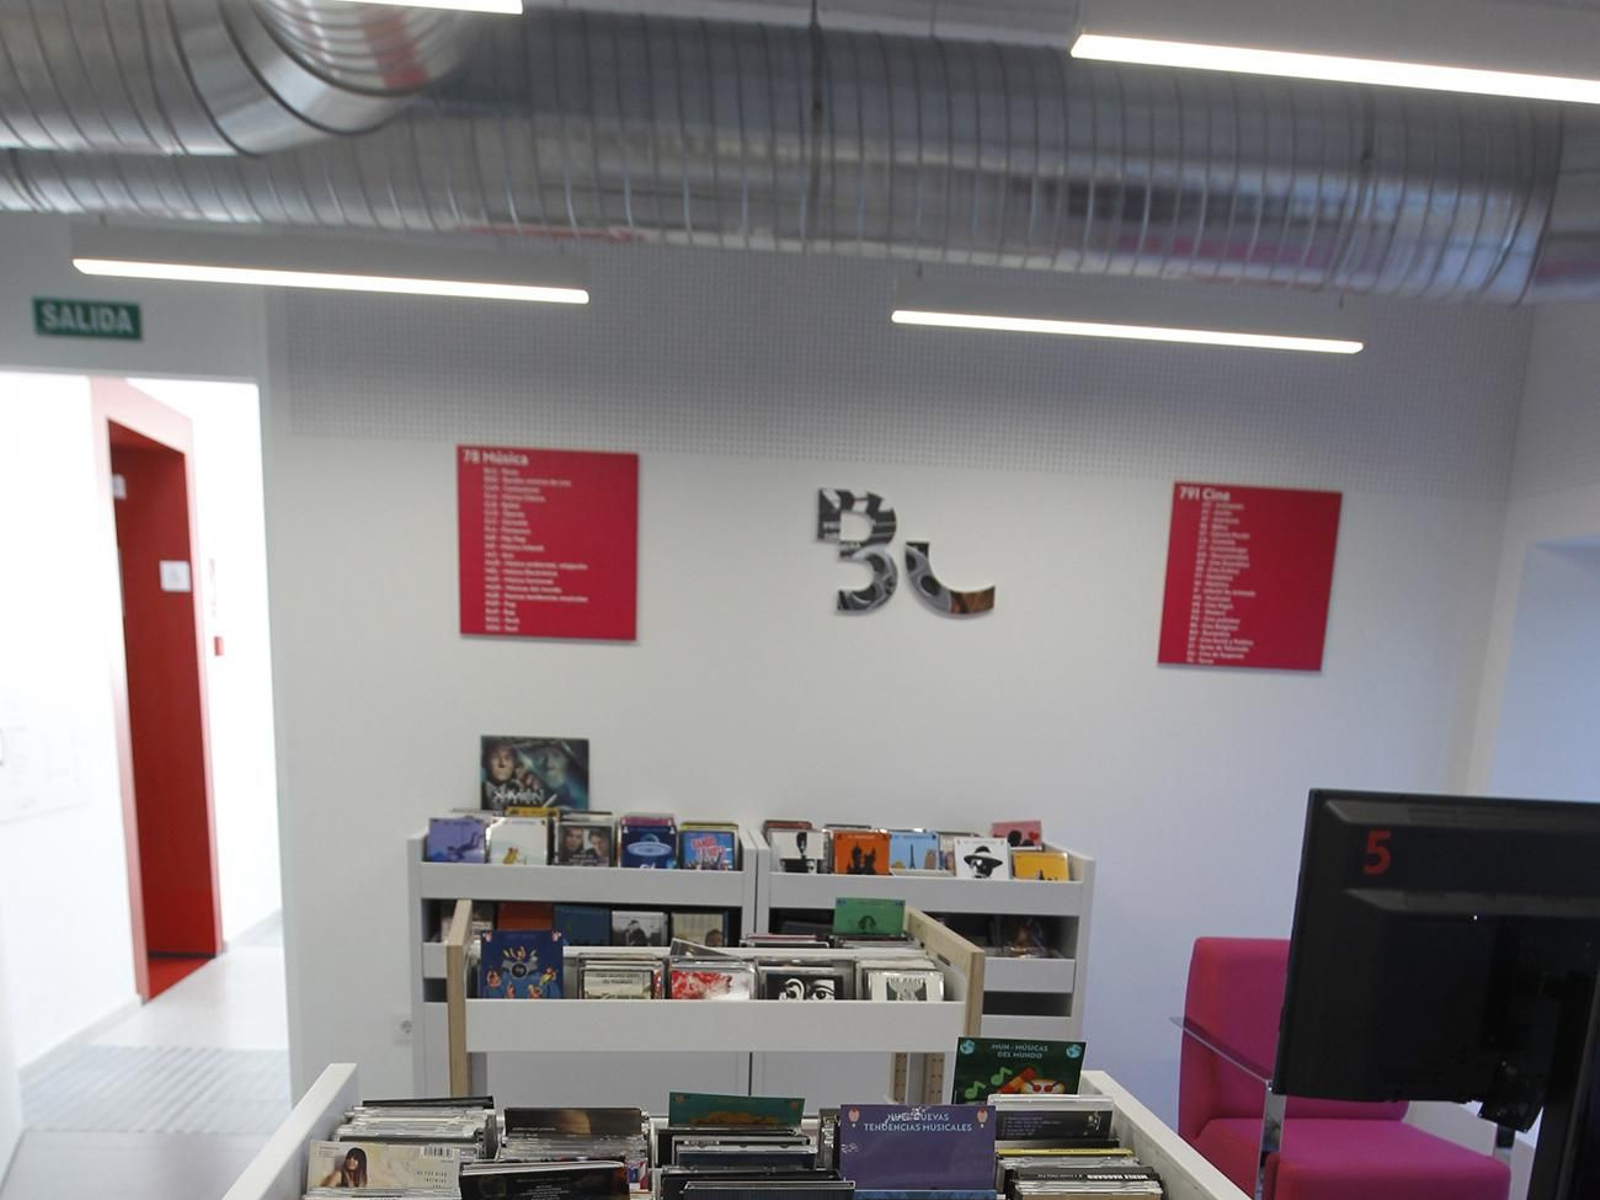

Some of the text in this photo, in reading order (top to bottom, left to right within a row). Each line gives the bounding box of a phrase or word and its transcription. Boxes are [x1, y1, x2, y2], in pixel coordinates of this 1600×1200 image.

[42, 302, 134, 335] SALIDA
[1179, 486, 1231, 501] 791 Cine
[1362, 830, 1392, 876] 5
[863, 1123, 973, 1132] TENDENCIAS MUSICALES
